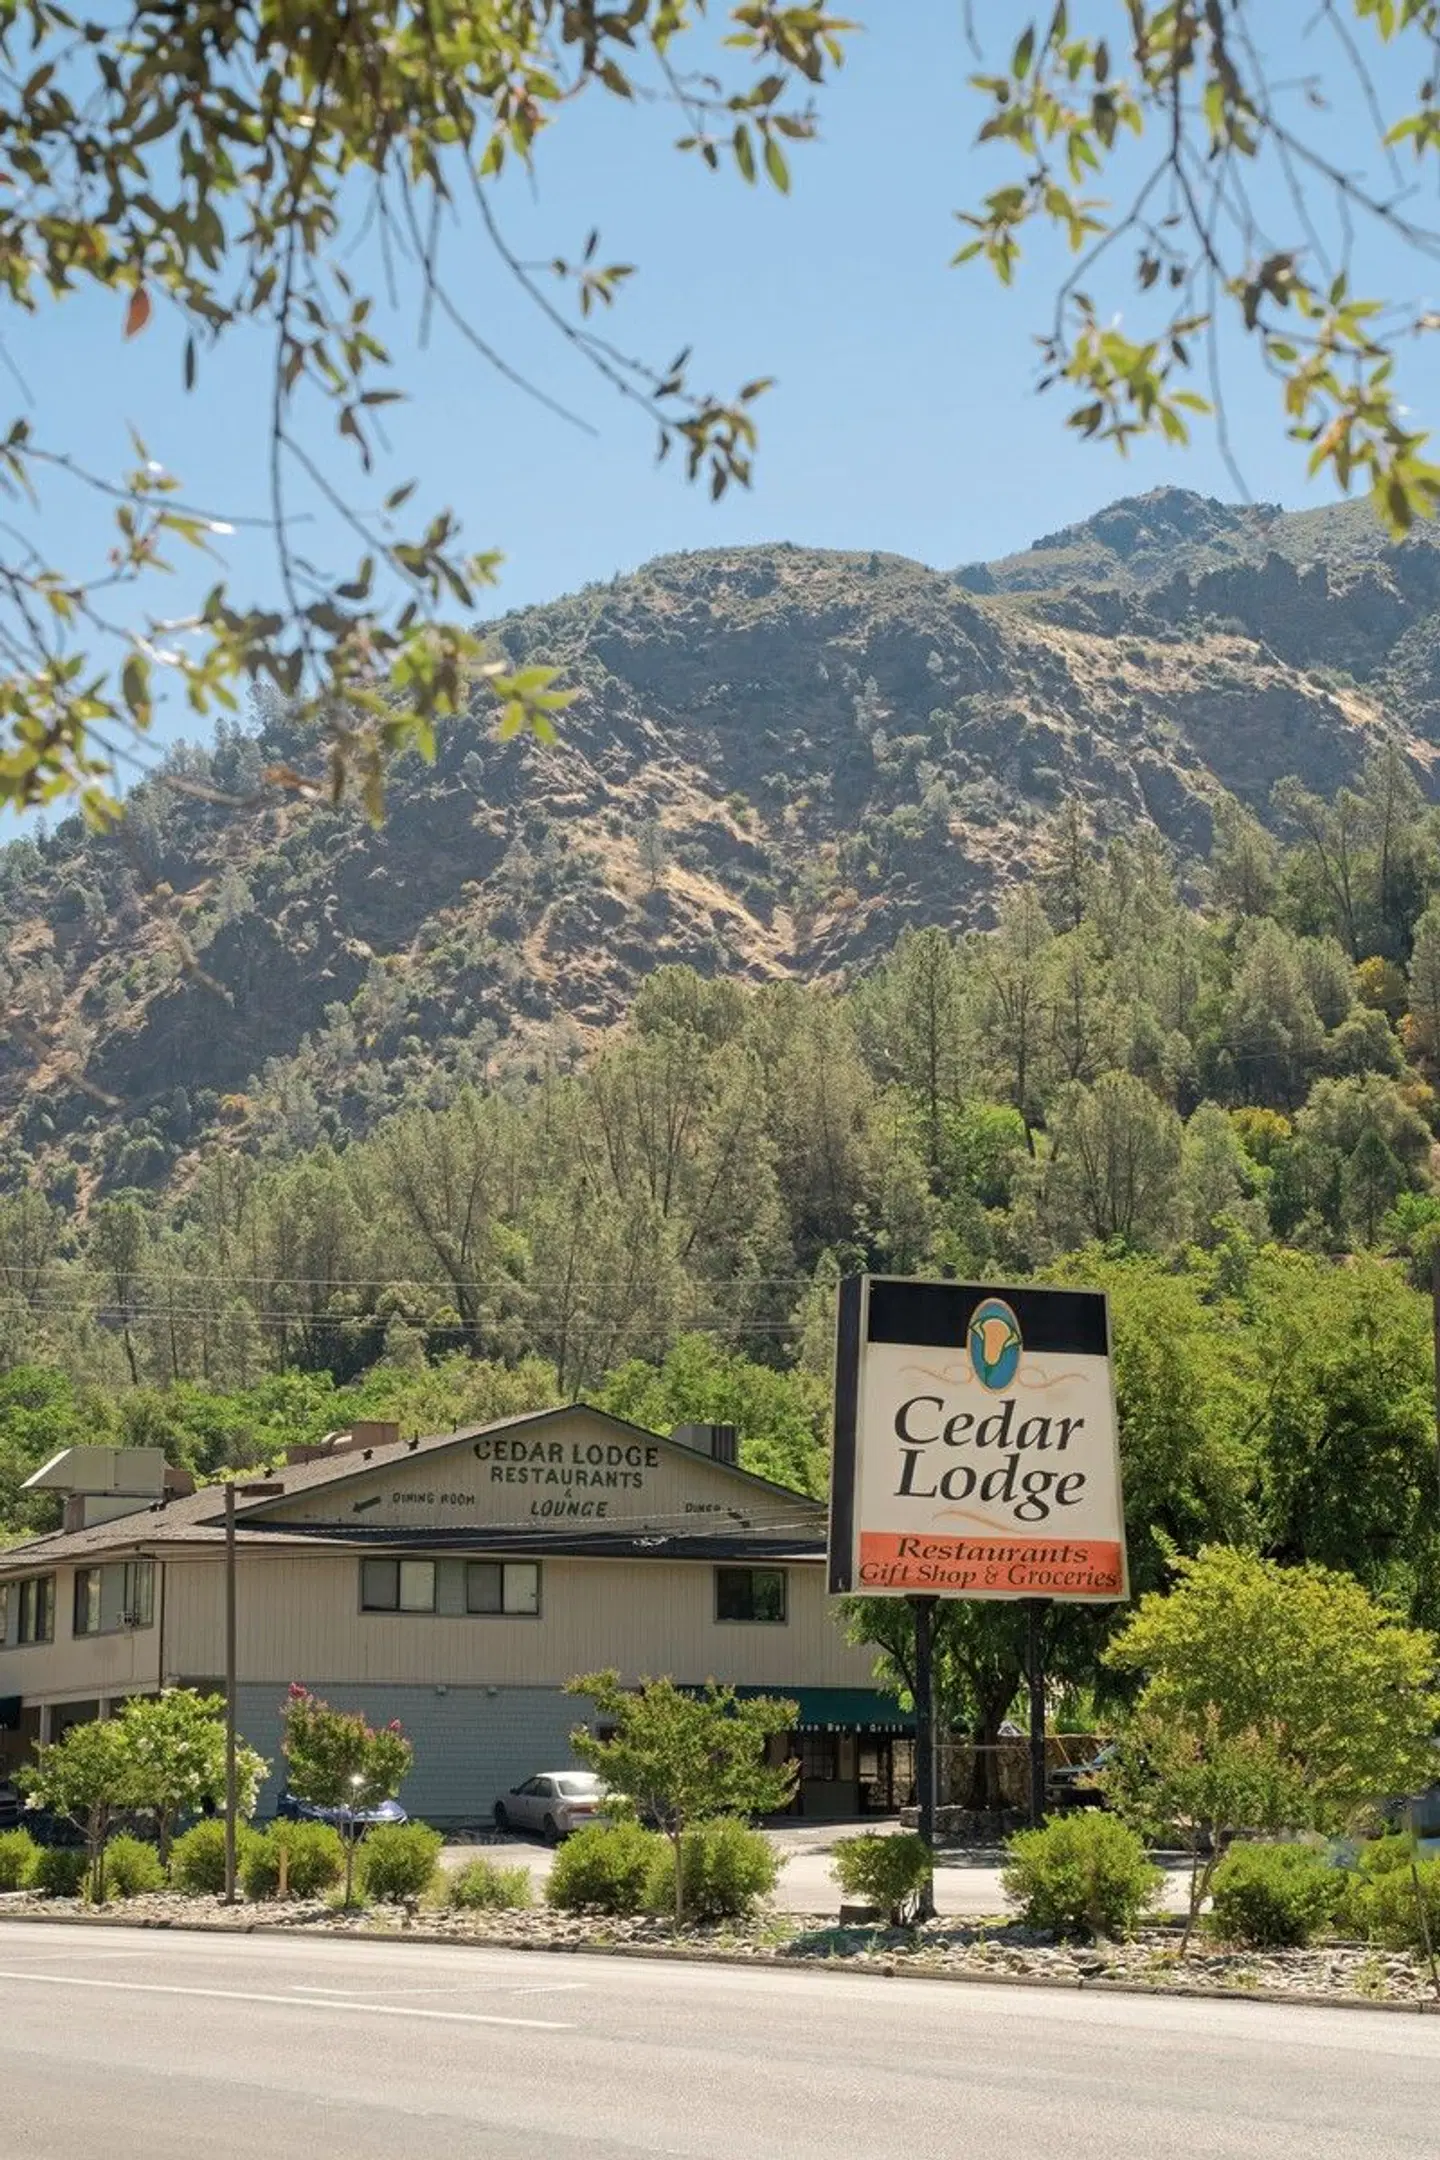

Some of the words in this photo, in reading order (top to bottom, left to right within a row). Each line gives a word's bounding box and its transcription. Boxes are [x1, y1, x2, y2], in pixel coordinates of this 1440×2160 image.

[894, 1395, 1085, 1450] Cedar
[474, 1441, 564, 1463] CEDAR
[572, 1444, 658, 1468] LODGE
[490, 1466, 643, 1489] RESTAURANTS
[893, 1448, 1086, 1522] Lodge
[393, 1492, 435, 1505] DINING
[441, 1493, 475, 1506] ROOM
[530, 1499, 608, 1518] LOUNGE
[897, 1537, 1089, 1564] Restaurants
[859, 1562, 909, 1587] Gift
[916, 1563, 977, 1589] Shop
[984, 1565, 998, 1585] &
[1007, 1565, 1118, 1588] Groceries
